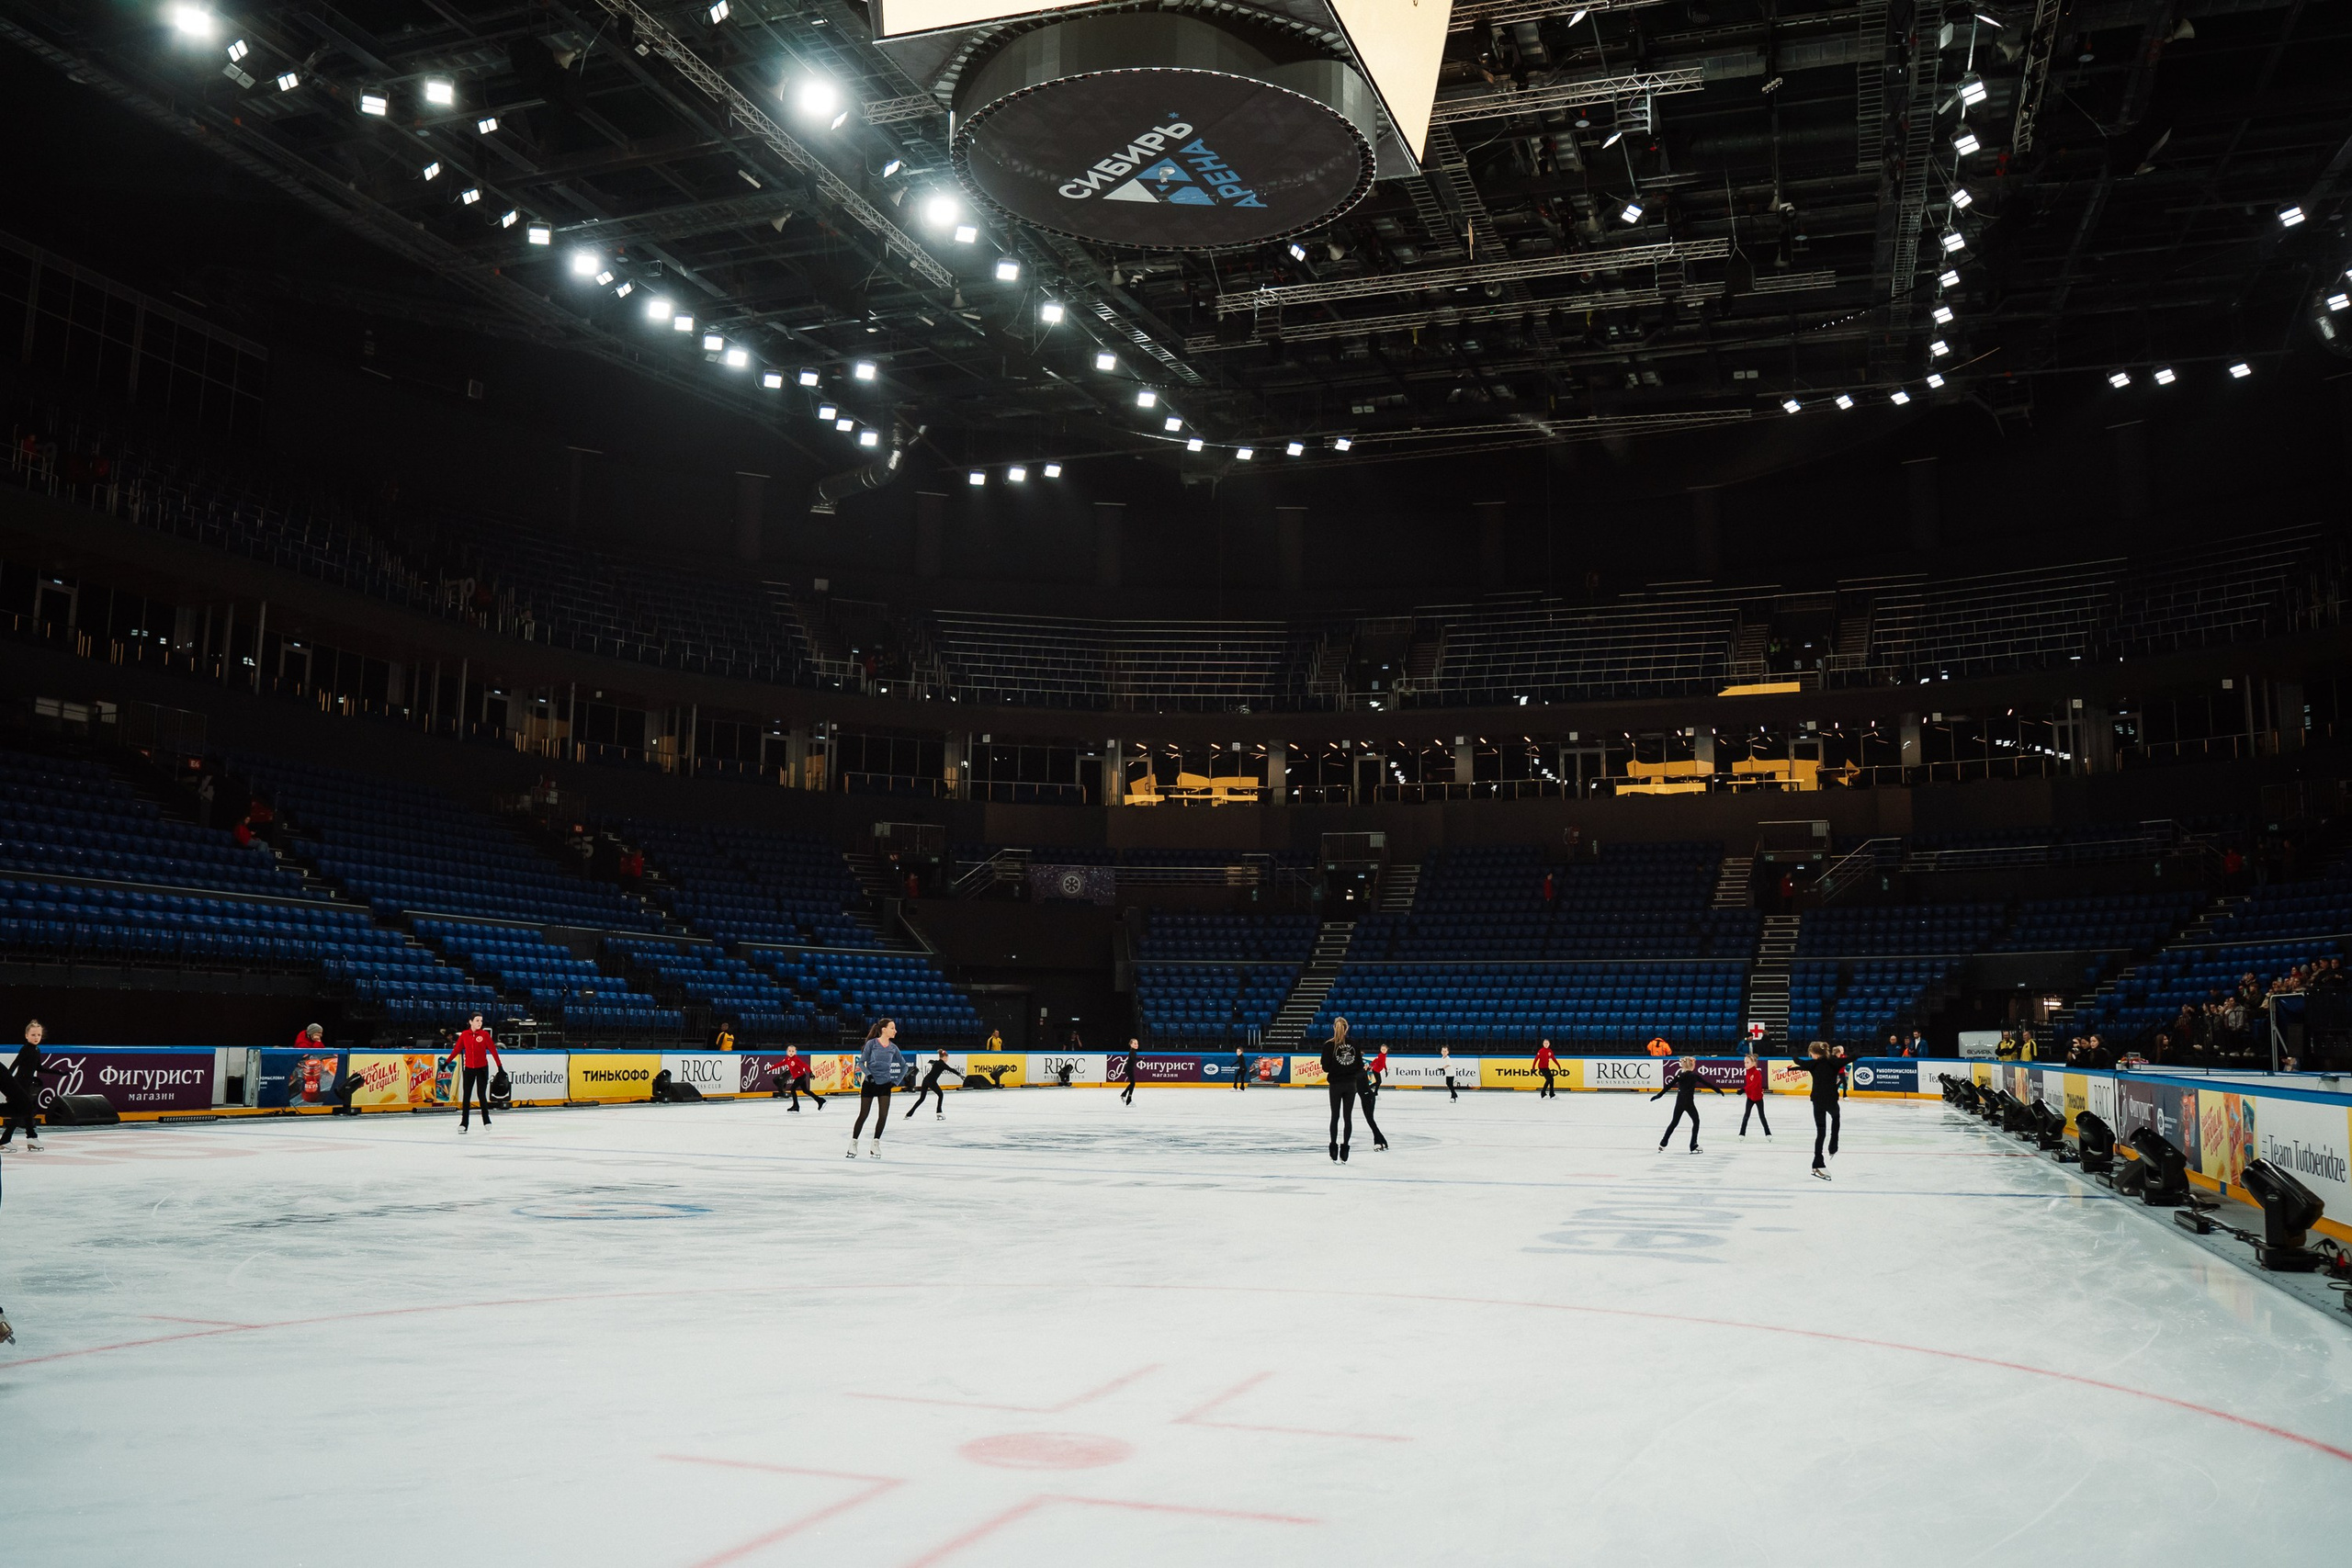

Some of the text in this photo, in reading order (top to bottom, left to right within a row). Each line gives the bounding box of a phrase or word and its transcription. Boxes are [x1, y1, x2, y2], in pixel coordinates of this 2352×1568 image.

[1058, 122, 1193, 199] СИБИРЬ
[1179, 138, 1268, 208] АРЕНА
[681, 1059, 723, 1082] RRCC
[974, 1065, 1018, 1073] ТИНЬКФФ
[1136, 1060, 1195, 1073] Фигурист
[1396, 1067, 1476, 1077] Team Tutidze
[1596, 1062, 1651, 1079] RRCC
[1697, 1065, 1762, 1079] Фигури
[99, 1066, 205, 1090] Фигурист
[376, 1069, 400, 1092] едим!
[509, 1070, 564, 1085] Tutberidze
[583, 1068, 650, 1082] ТИНЬКОФФ
[128, 1092, 175, 1101] магазин
[2268, 1134, 2293, 1169] Team
[2293, 1140, 2346, 1183] Tutberidze
